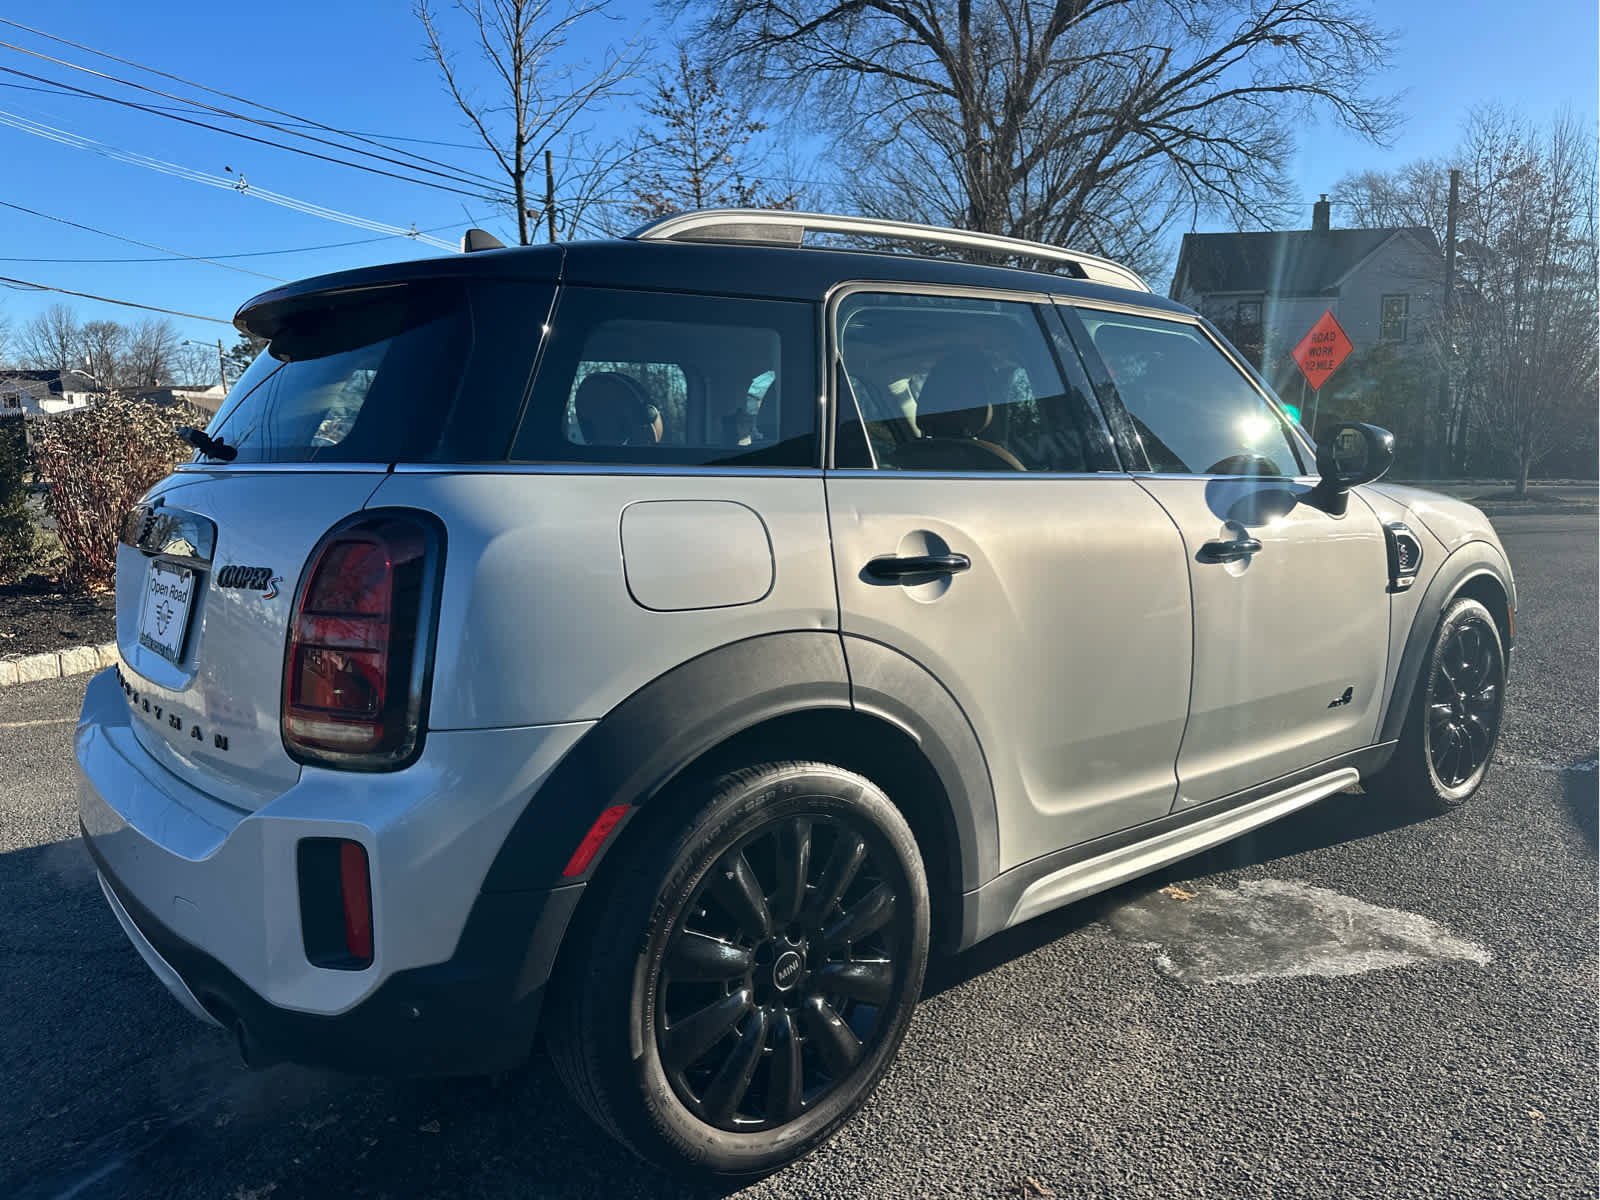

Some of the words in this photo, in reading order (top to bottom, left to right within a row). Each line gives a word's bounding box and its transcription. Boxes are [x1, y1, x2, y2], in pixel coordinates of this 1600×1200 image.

[1312, 331, 1336, 343] ROAD
[1309, 346, 1333, 357] WORK
[1317, 359, 1334, 370] MILE
[151, 577, 169, 597] Open
[169, 583, 188, 604] Road
[217, 564, 273, 591] COOPER
[262, 576, 284, 600] S
[778, 959, 799, 981] MINI
